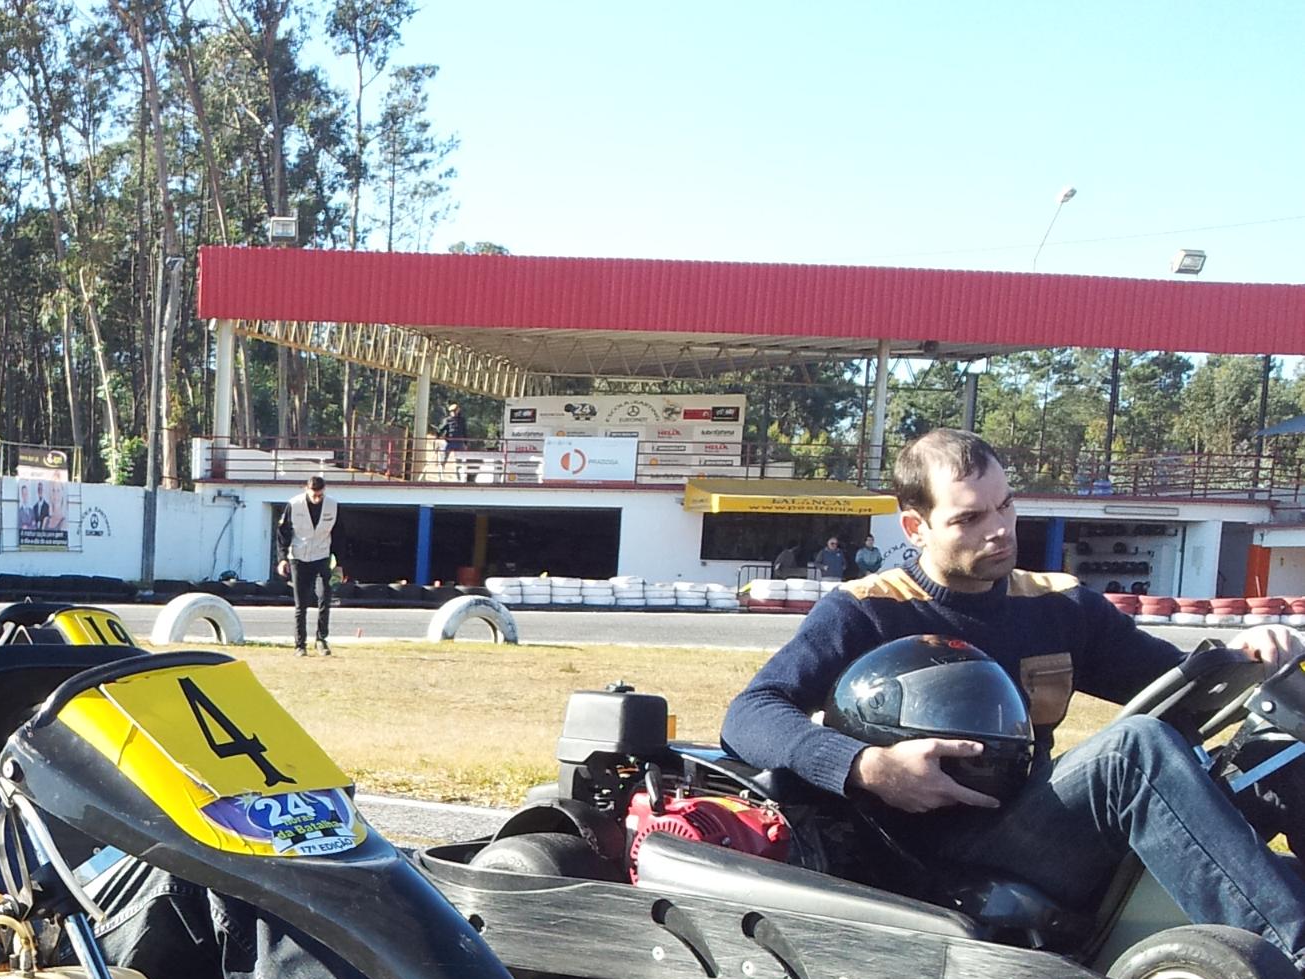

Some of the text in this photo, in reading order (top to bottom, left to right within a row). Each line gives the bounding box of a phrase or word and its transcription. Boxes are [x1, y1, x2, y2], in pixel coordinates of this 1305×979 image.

[178, 676, 298, 787] 4
[254, 792, 316, 826] 24
[277, 819, 340, 840] da Batalha
[320, 836, 354, 852] EDIÇÃO
